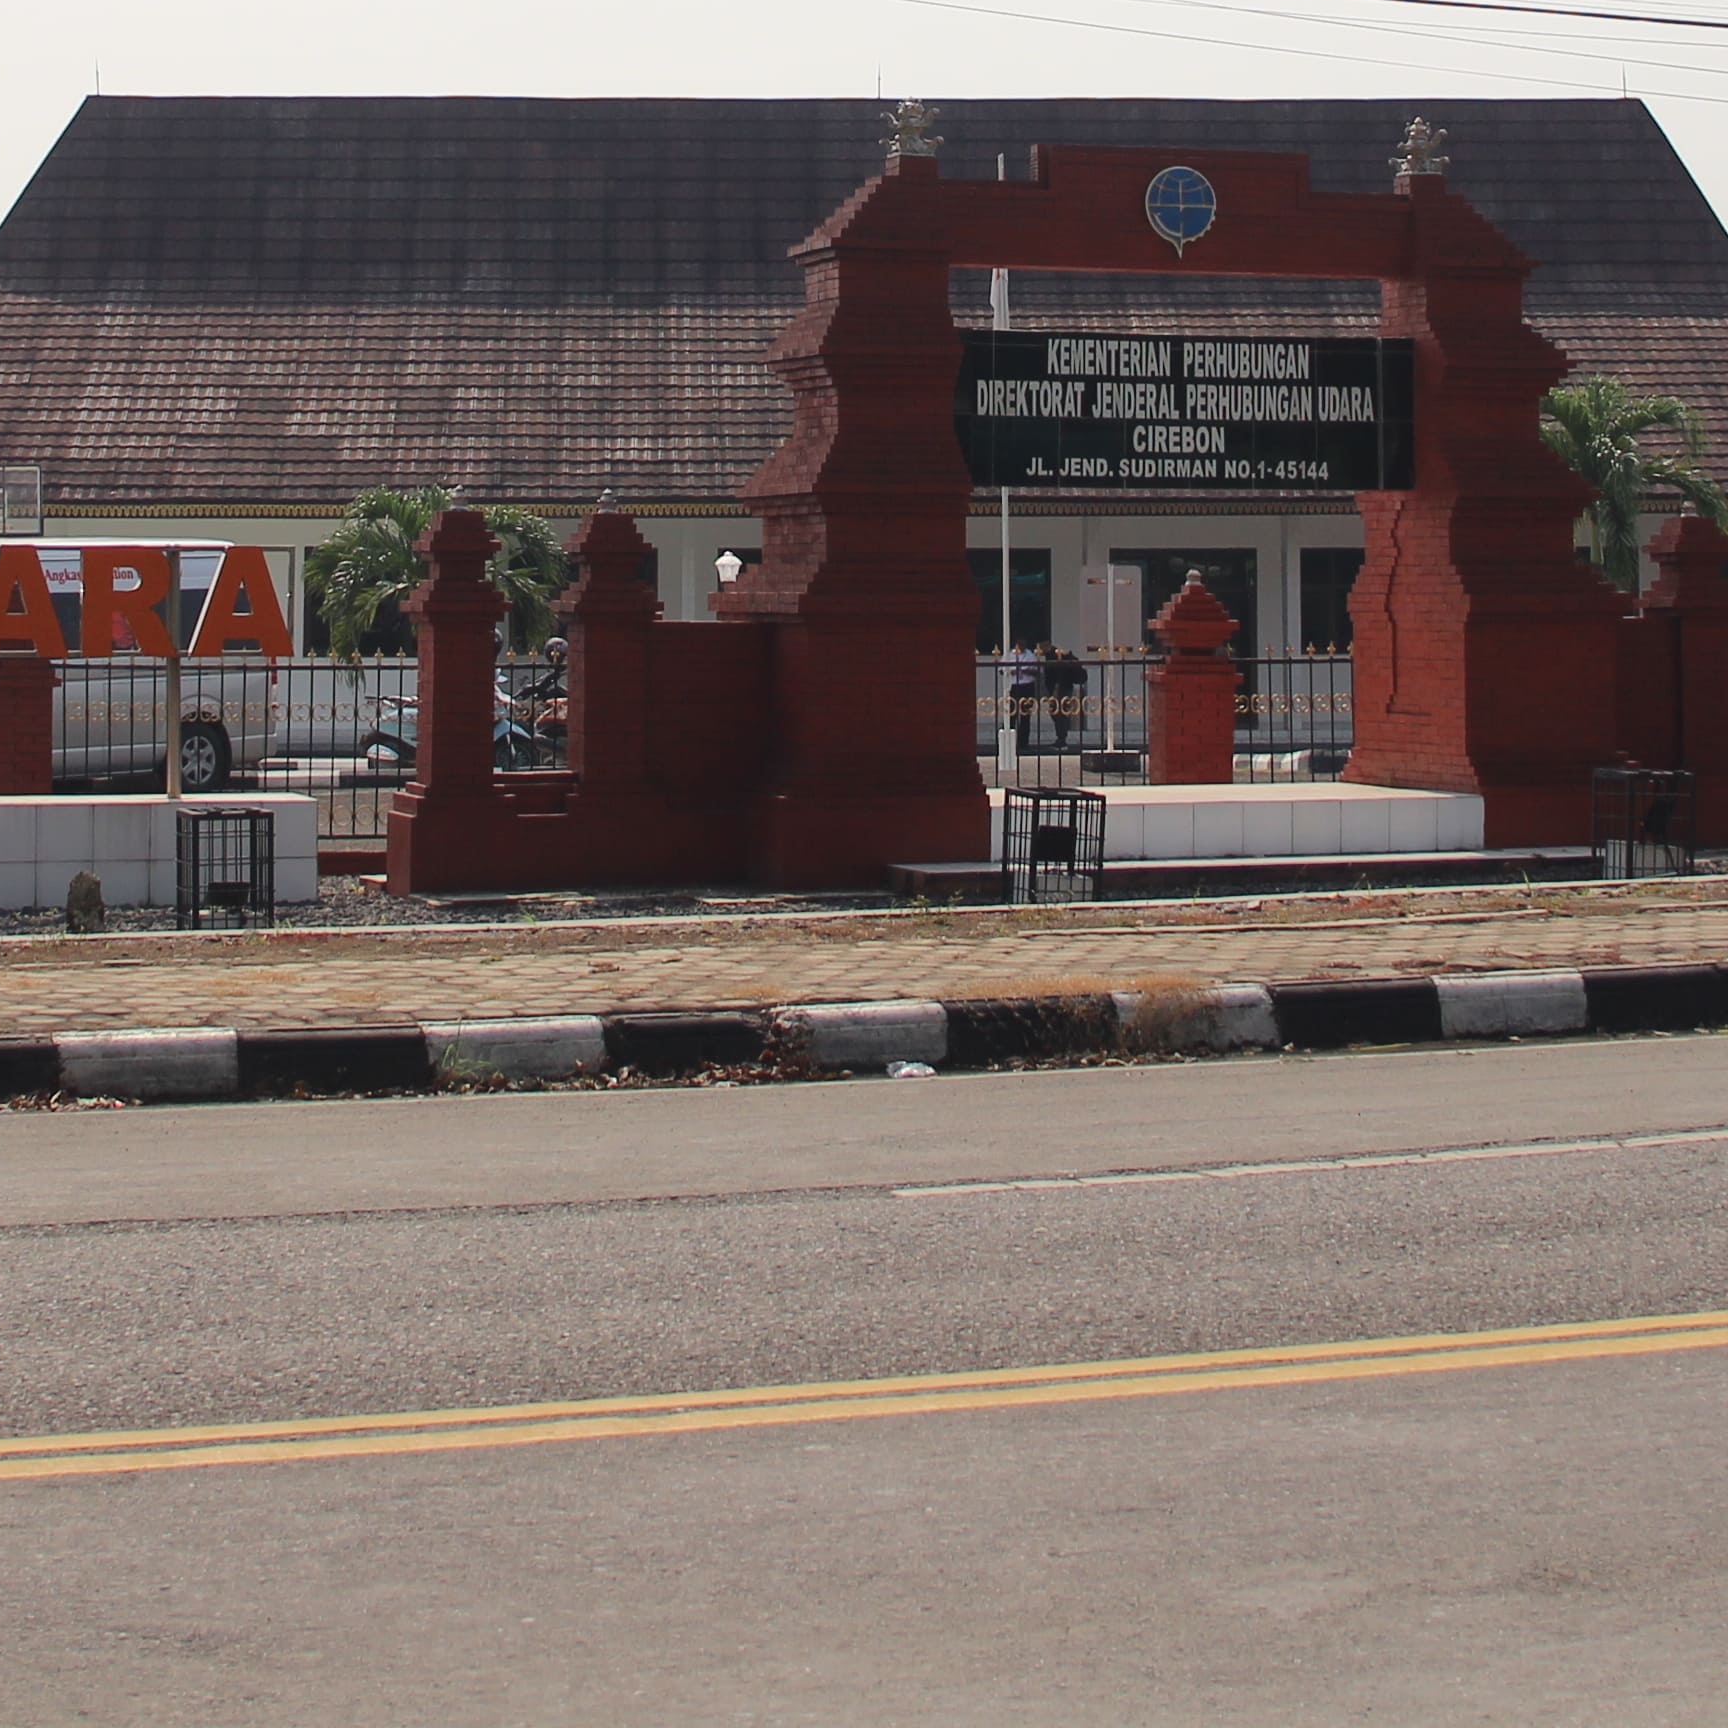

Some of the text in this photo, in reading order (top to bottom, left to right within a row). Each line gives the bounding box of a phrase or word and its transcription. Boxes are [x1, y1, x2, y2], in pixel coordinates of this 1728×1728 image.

[1047, 338, 1309, 379] KEMENTERIAN PERHUBUNGAN
[976, 379, 1374, 422] DIREKTORAT JENDERAL PERHUBUNGAN UDARA
[1132, 425, 1225, 453] CIREBON
[1026, 457, 1053, 476] JL.
[1059, 458, 1114, 476] JEND.
[1119, 459, 1217, 478] SUDIRMAN
